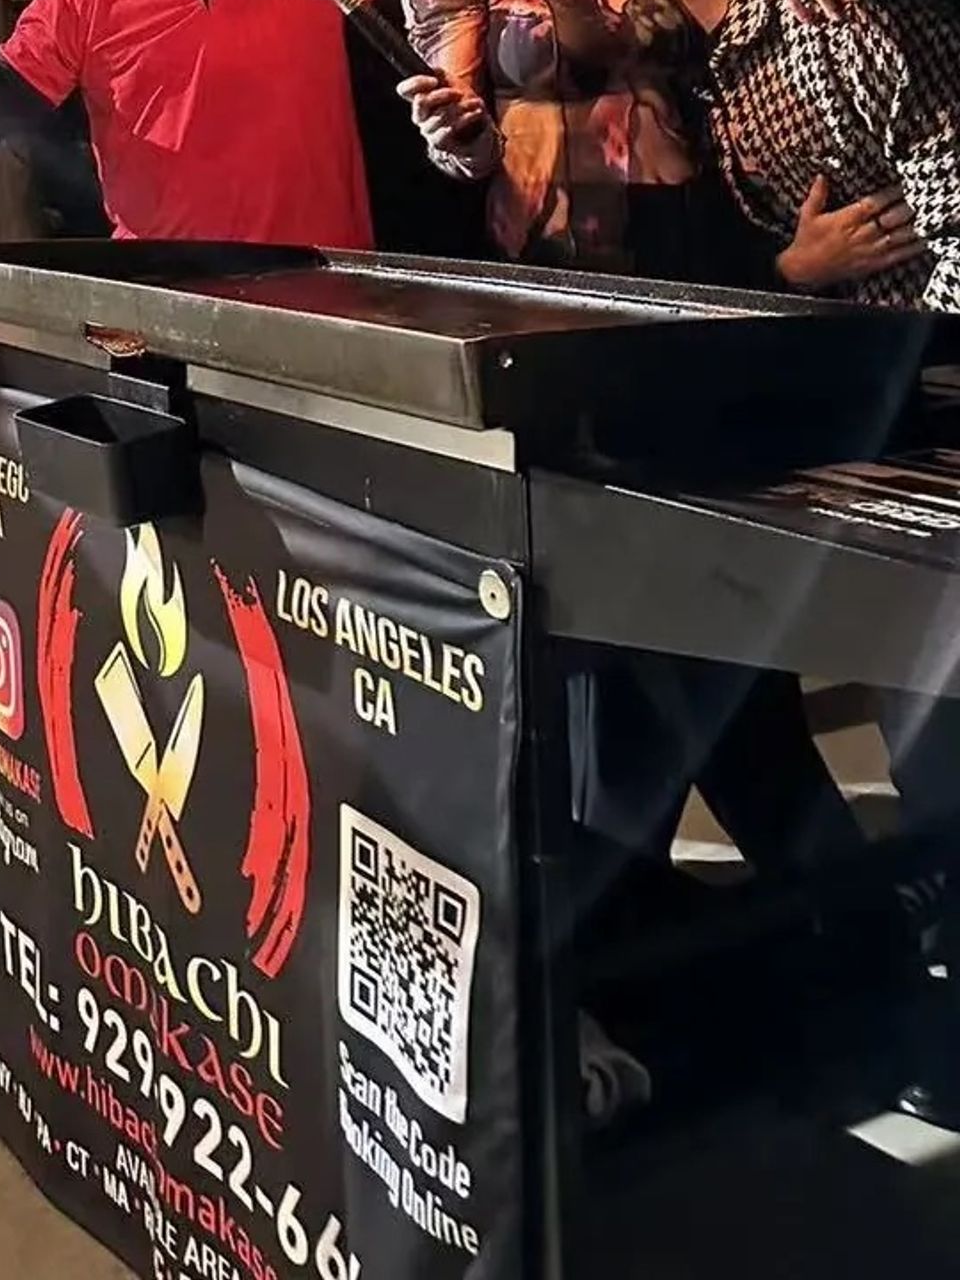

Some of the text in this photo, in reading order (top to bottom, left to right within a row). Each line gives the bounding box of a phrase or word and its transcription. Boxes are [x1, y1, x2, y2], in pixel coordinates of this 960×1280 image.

[277, 569, 485, 712] LOS ANGELES
[354, 667, 397, 736] CA
[0, 910, 61, 1033] TEL:
[66, 1141, 90, 1177] CT
[409, 1119, 472, 1198] Code
[401, 1167, 480, 1256] Online
